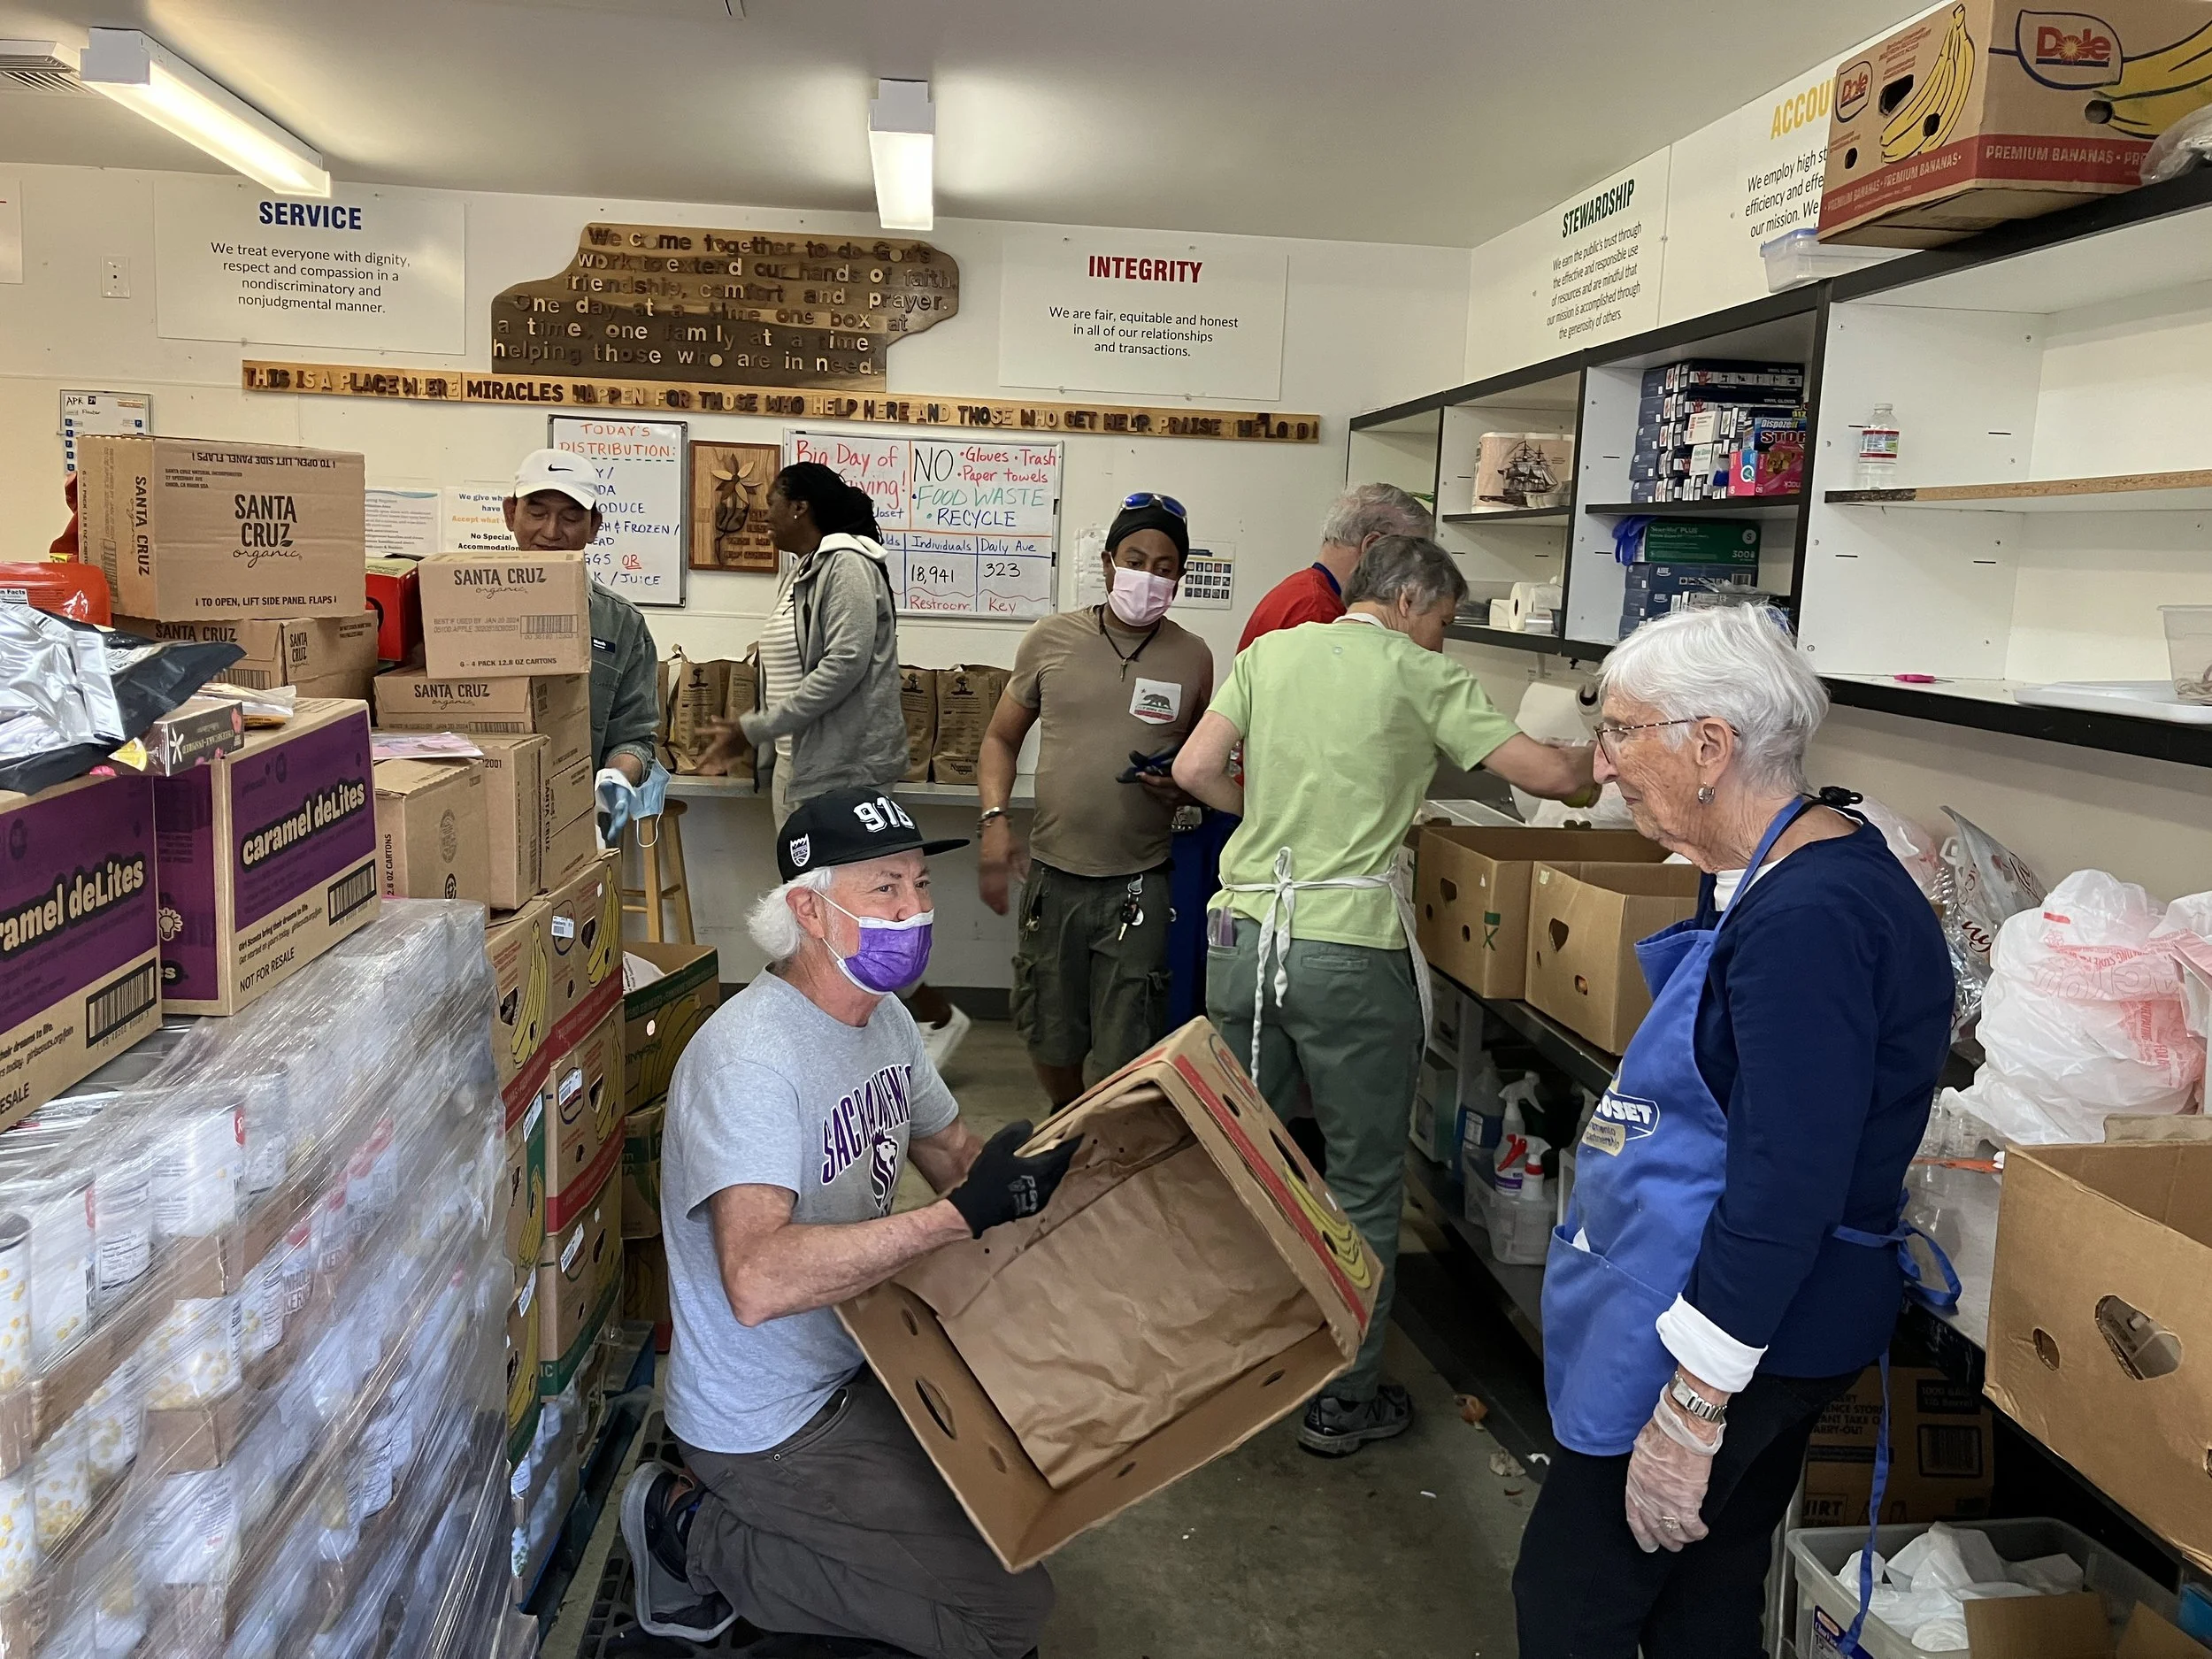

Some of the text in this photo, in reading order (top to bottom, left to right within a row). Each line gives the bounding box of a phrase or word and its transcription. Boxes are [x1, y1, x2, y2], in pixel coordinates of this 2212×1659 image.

[2037, 26, 2112, 61] Dole
[1841, 73, 1869, 103] Dole
[1985, 145, 2114, 165] PREMIUM BANANAS
[1747, 150, 1816, 193] We employ high
[1883, 154, 1958, 189] PREMIUM BANANAS
[1746, 179, 1802, 217] efficiency and
[259, 201, 362, 230] SERVICE
[1562, 179, 1635, 238] STEWARDSHIP
[1750, 199, 1819, 237] our mission. We
[1618, 220, 1642, 242] through
[588, 227, 621, 248] We
[629, 233, 692, 250] come
[704, 234, 795, 257] together
[805, 241, 828, 258] to
[838, 242, 863, 259] do
[211, 242, 411, 267] We treat everyone with dignity,
[223, 260, 399, 281] respect and compassion in a
[666, 258, 742, 276] extend
[755, 262, 787, 279] our
[799, 264, 863, 283] hands
[870, 265, 892, 284] of
[1088, 255, 1203, 283] INTEGRITY
[242, 278, 381, 297] nondiscriminatory and
[238, 295, 386, 314] nonjudgmental manner.
[803, 288, 949, 313] and prayer.
[576, 296, 909, 333] day one box at
[1049, 306, 1239, 328] We are fair, equitable and honest
[605, 324, 649, 340] one
[1073, 324, 1213, 344] in all of our relationships
[493, 339, 879, 375] helping those are in need.
[1094, 342, 1191, 357] and transactions.
[246, 367, 290, 388] THIS
[296, 370, 315, 388] IS
[320, 371, 333, 391] A
[340, 372, 399, 396] PLACE
[399, 375, 459, 398] WHERE
[466, 380, 564, 403] MIRACLES
[572, 384, 644, 405] HAPPEN
[655, 389, 690, 409] FOR
[699, 391, 758, 412] THOSE
[766, 395, 804, 415] WHO
[813, 395, 857, 417] HELP
[864, 398, 910, 422] HERE
[910, 403, 950, 425] AND
[958, 405, 1014, 426] THOSE
[1020, 408, 1058, 428] WHO
[1064, 411, 1098, 430] GET
[1158, 413, 1222, 436] PRAISE
[580, 424, 650, 437] TODAY'S
[559, 442, 676, 457] DISTRIBUTION:
[796, 440, 899, 477] Big Day of
[965, 447, 1056, 467] Gloves Trash
[913, 447, 954, 482] NO
[962, 465, 1048, 483] Paper towels
[916, 485, 1045, 510] FOOD WASTE
[234, 494, 297, 523] SANTA
[937, 508, 1017, 528] RECYCLE
[135, 476, 150, 576] SANTA CRUZ
[452, 515, 479, 524] Accept
[624, 521, 670, 534] FROZEN
[241, 522, 293, 548] CRUZ
[482, 533, 512, 541] Special
[911, 535, 972, 552] Individuals
[457, 542, 520, 551] Accommodation
[980, 537, 1037, 555] Daily Ave
[233, 549, 300, 568] organic
[622, 554, 640, 567] OR
[454, 568, 547, 586] SANTA CRUZ
[911, 564, 954, 584] 18,941
[983, 563, 1021, 578] 323
[202, 595, 332, 607] TO OPEN, LIFT SIDE PANEL FLAPS
[476, 587, 526, 599] organic
[988, 597, 1017, 614] Key
[156, 624, 238, 641] SANTA CRUZ
[290, 631, 307, 649] SANTA
[291, 646, 307, 662] CRUZ
[414, 684, 490, 699] SANTA CRUZ
[432, 699, 473, 710] organic
[242, 782, 365, 865] caramel deLites
[853, 795, 916, 833] 916
[69, 860, 144, 919] deLites
[240, 947, 296, 993] NOT FOR RESALE
